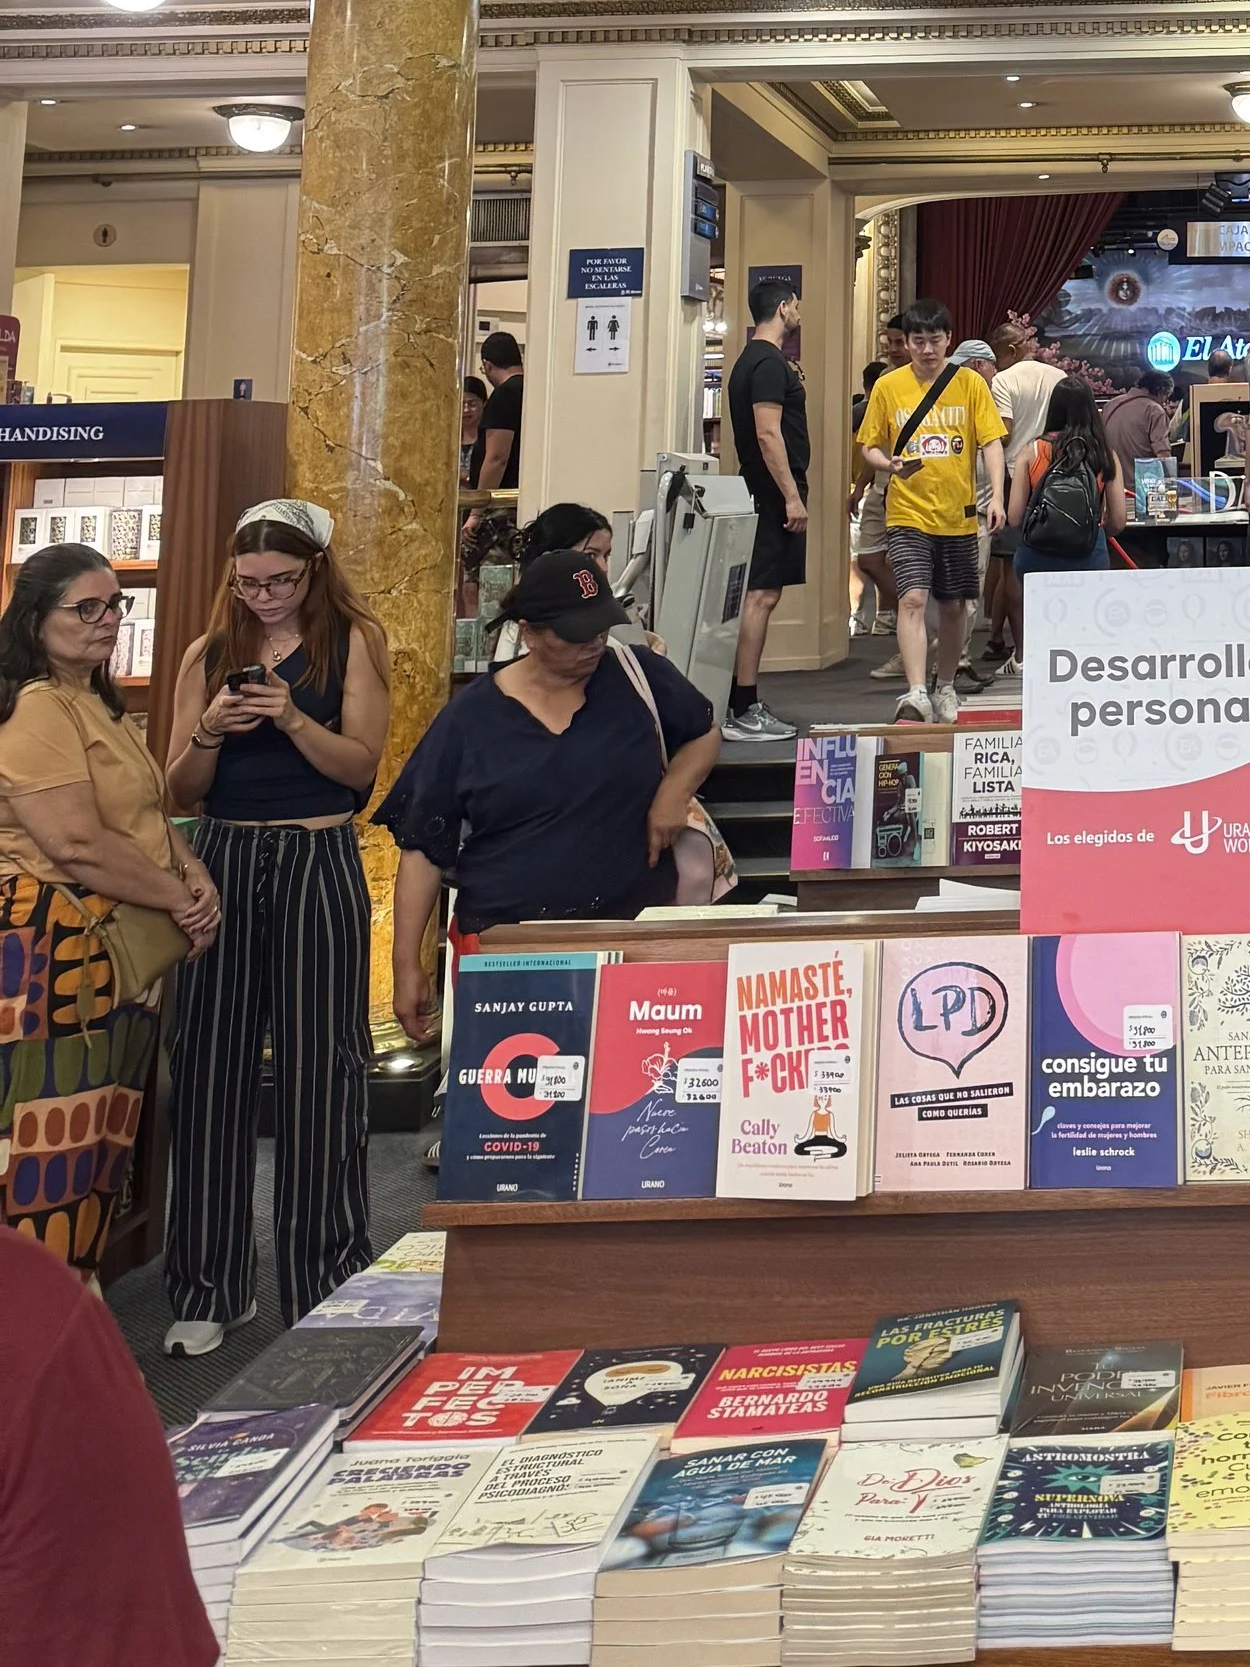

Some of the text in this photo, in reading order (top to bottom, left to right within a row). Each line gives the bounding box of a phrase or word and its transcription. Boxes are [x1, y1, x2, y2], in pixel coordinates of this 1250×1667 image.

[1219, 225, 1248, 235] CAJA
[1182, 336, 1214, 361] El
[896, 408, 939, 426] OSA
[572, 569, 599, 600] B
[797, 735, 856, 761] INFLU
[965, 737, 1022, 750] FAMILIA
[974, 752, 1015, 763] RICA,
[964, 766, 1022, 779] FAMILIA
[972, 781, 1015, 794] LISTA
[968, 824, 1019, 836] ROBERT
[1047, 829, 1155, 848] Los elegidos de
[737, 950, 853, 1012] NAMASTÉ,
[474, 1001, 573, 1014] SANJAY GUPTA
[629, 1000, 702, 1021] Maum
[910, 985, 996, 1037] LPD
[739, 999, 849, 1055] MOTHER
[1042, 1052, 1167, 1079] consigue tu
[1204, 1066, 1231, 1075] PARA
[459, 1069, 511, 1084] GUERRA
[1049, 1075, 1160, 1097] embarazo
[895, 1087, 1010, 1105] LAS COSAS QUE NO SALIERON
[922, 1108, 982, 1118] COMO QUERÍAS
[741, 1119, 780, 1140] Cally
[484, 1142, 540, 1152] COVID-19
[732, 1138, 787, 1155] Beaton
[1073, 1147, 1135, 1156] leslie schrock
[497, 1184, 518, 1192] URANO
[642, 1181, 664, 1189] URANO
[881, 1326, 910, 1336] LAS
[914, 1309, 1005, 1329] FRACTURAS
[876, 1332, 922, 1348] POR
[457, 1366, 519, 1380] IM
[719, 1361, 857, 1381] NARCISISTAS
[718, 1391, 828, 1407] BERNARDO
[707, 1401, 828, 1419] STAMATEAS
[502, 1449, 603, 1466] EL DIAGNÓSTICO
[684, 1448, 789, 1468] SANAR CON
[1022, 1451, 1150, 1462] ASTROMOSTRA
[332, 1462, 472, 1477] CRECIENDO
[495, 1458, 584, 1474] ESTRUCTURAL
[672, 1455, 797, 1479] AGUA DE MAR
[484, 1475, 571, 1492] DEL PROCESO
[1034, 1493, 1125, 1503] SUPERNOVA
